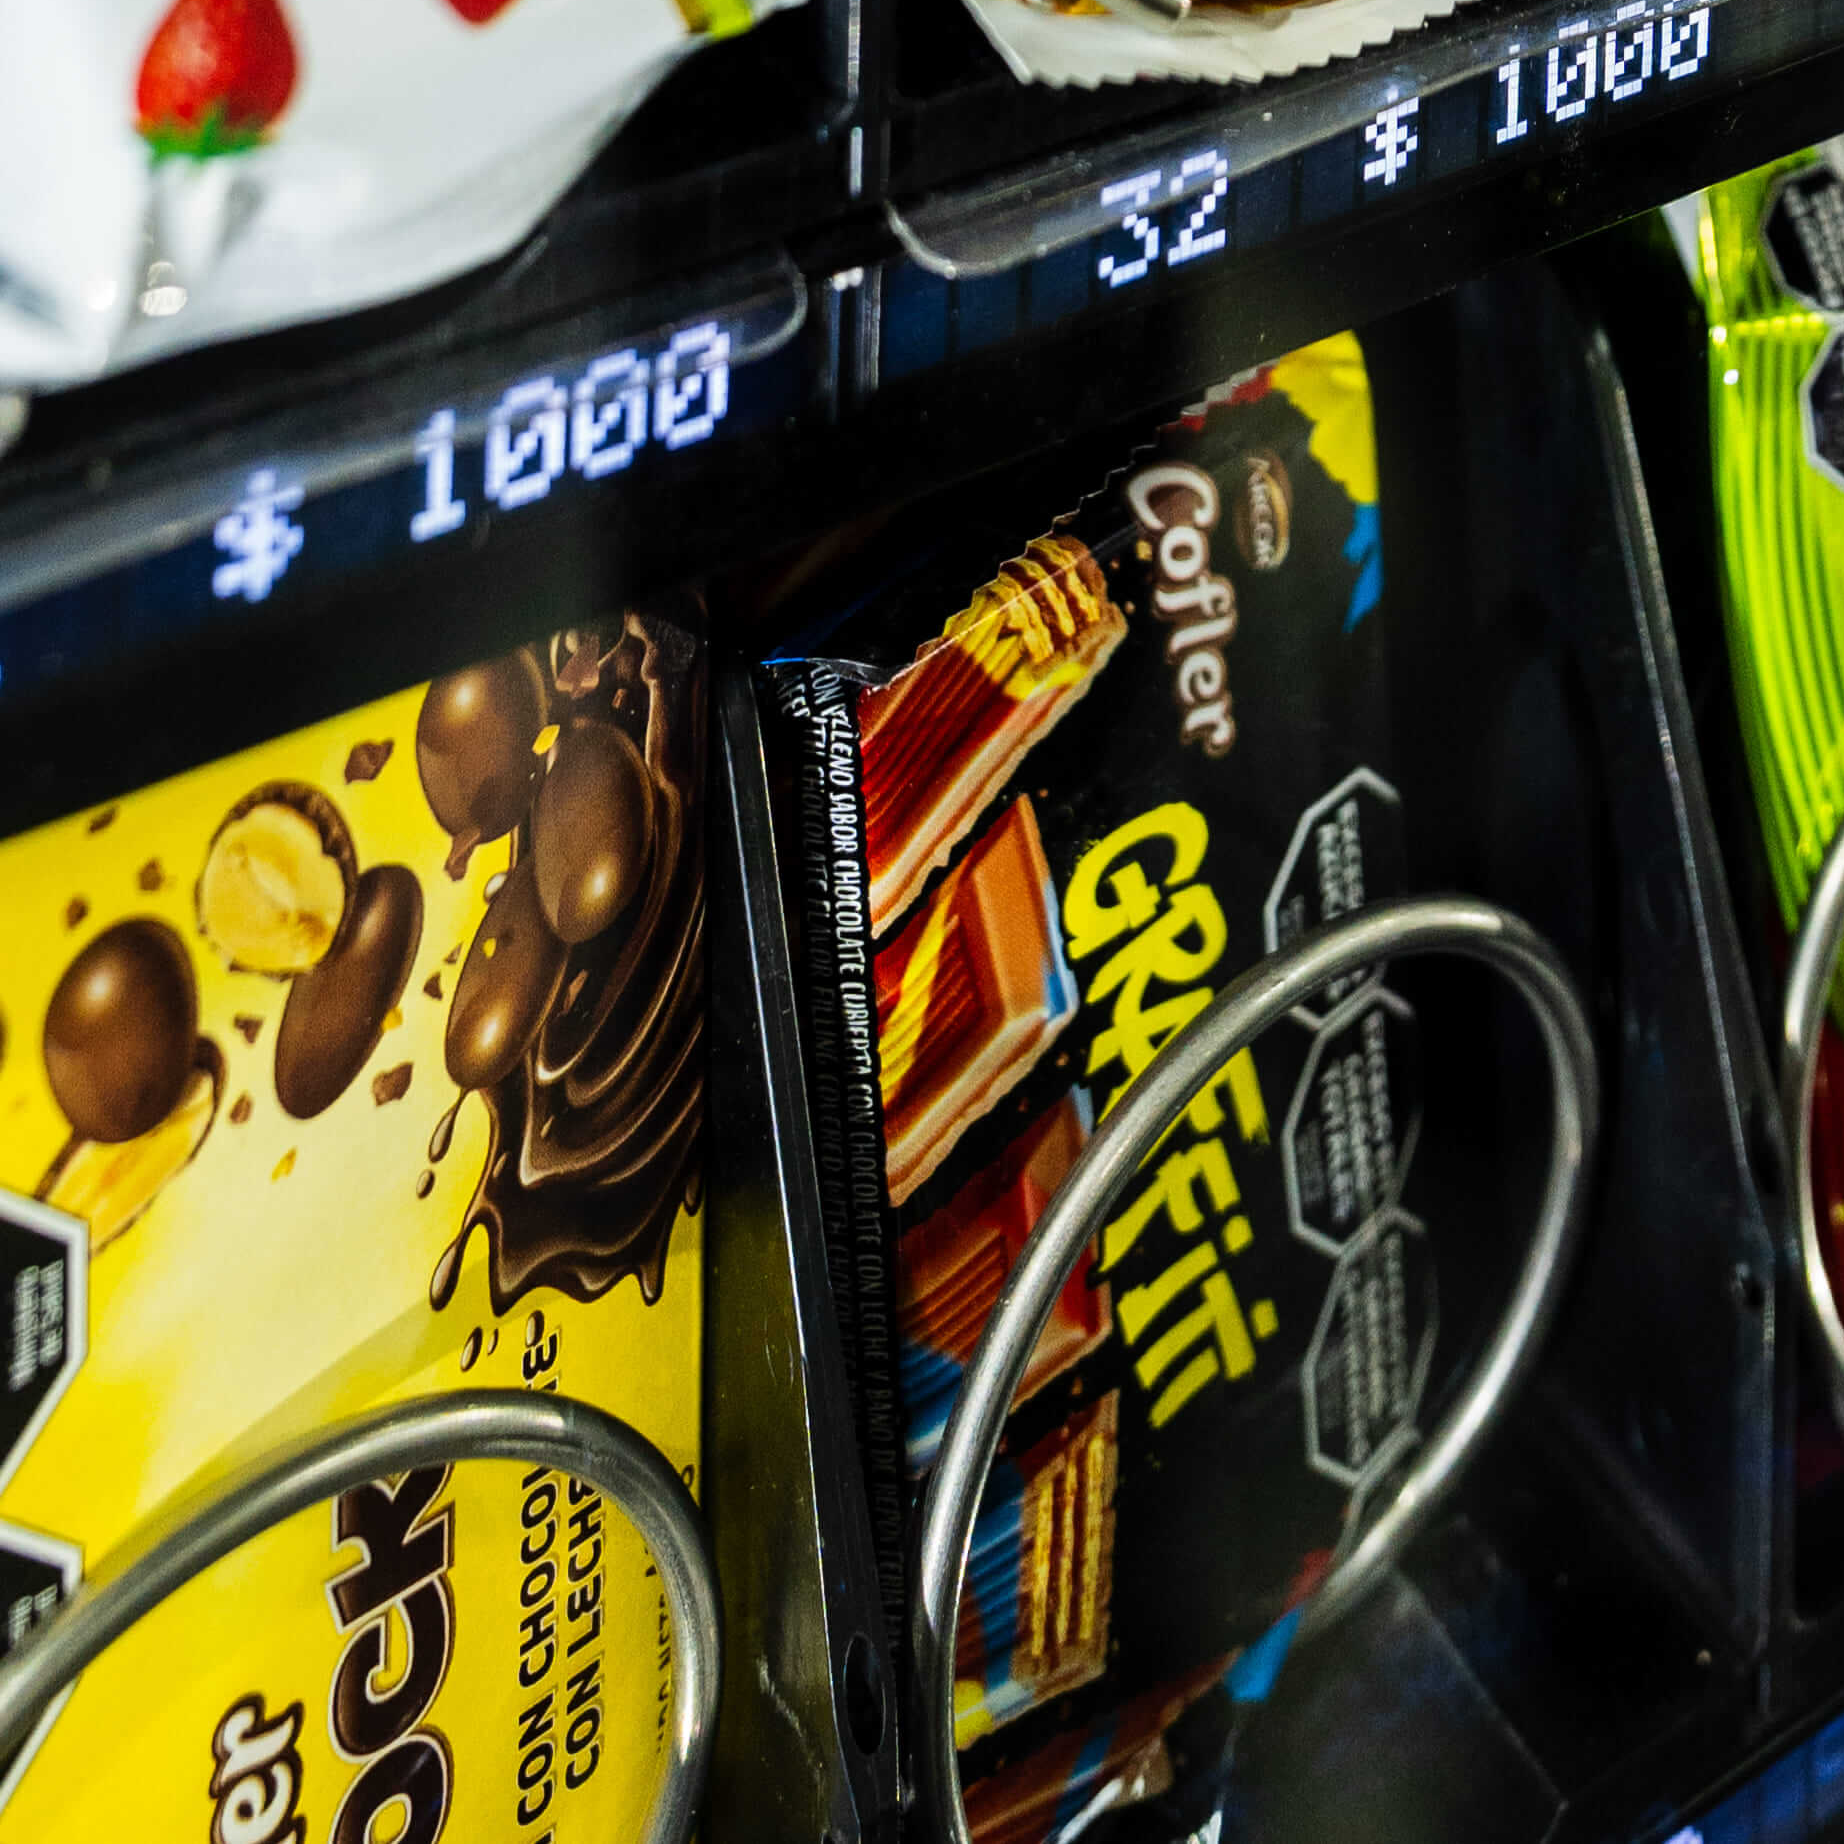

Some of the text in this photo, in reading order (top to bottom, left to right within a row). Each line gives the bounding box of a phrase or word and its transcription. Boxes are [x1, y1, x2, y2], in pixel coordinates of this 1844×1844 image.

[1098, 148, 1229, 289] 32
[1363, 81, 1419, 185] $
[211, 319, 731, 603] $ 1000
[1127, 465, 1235, 747] Cofler
[828, 791, 860, 855] SABOR
[831, 859, 866, 976] CHOCOLATE
[838, 979, 873, 1076] CUBIERTA
[516, 1688, 560, 1828] CON
[565, 1660, 602, 1791] CON
